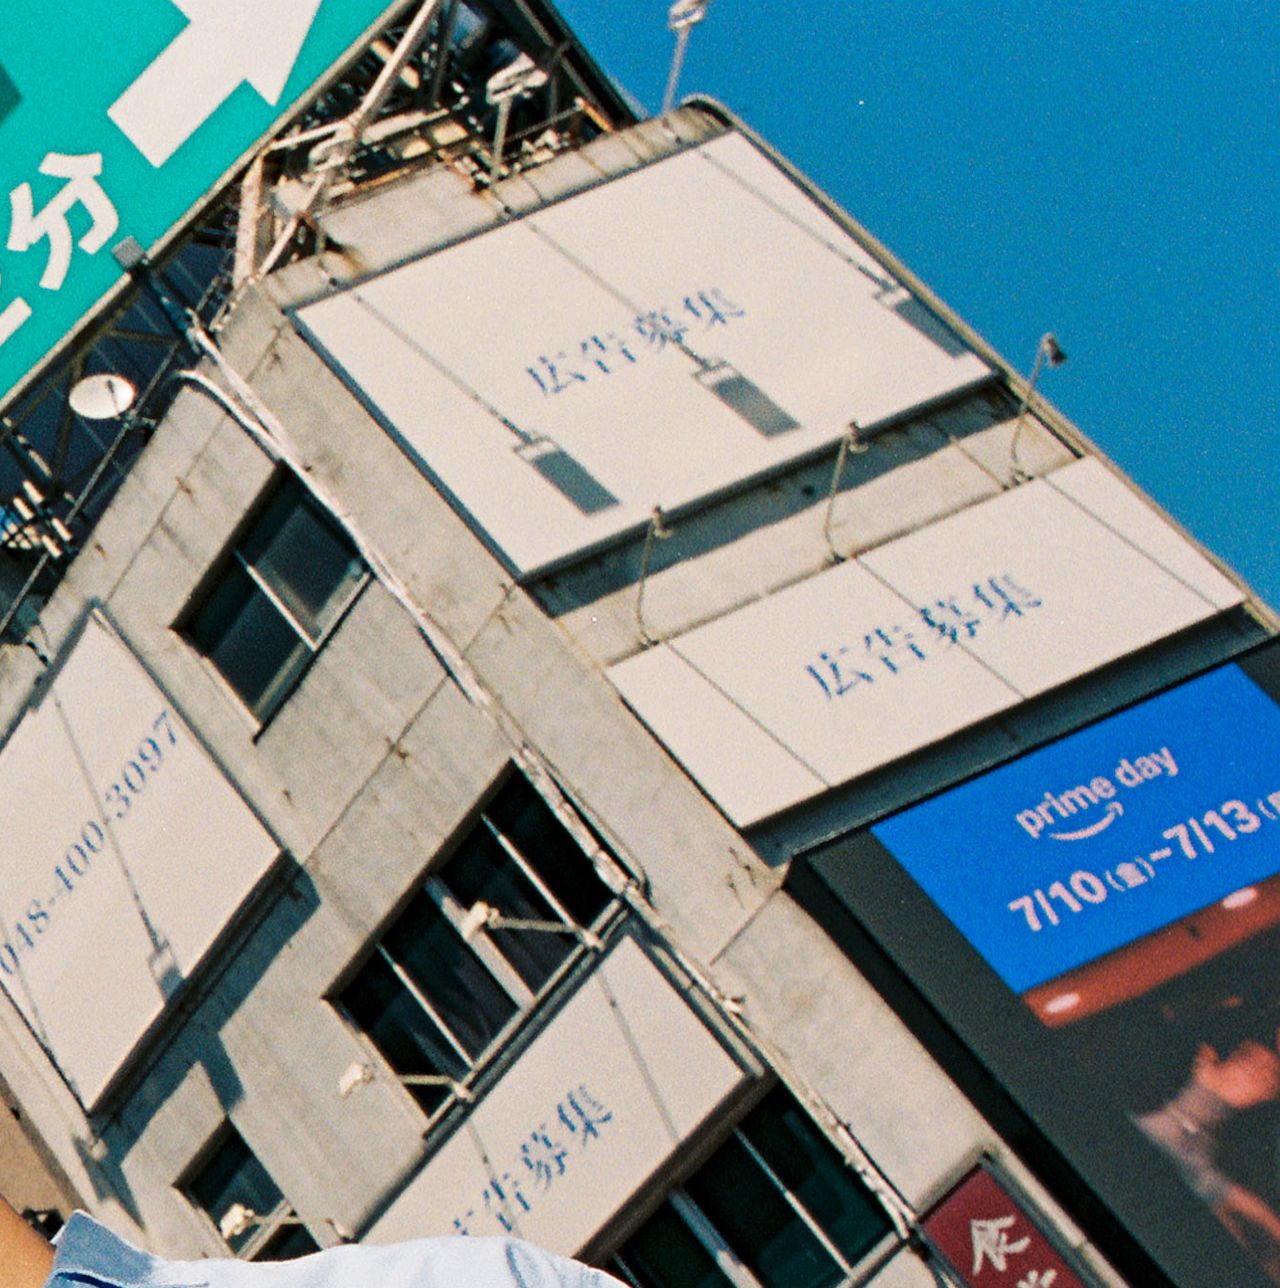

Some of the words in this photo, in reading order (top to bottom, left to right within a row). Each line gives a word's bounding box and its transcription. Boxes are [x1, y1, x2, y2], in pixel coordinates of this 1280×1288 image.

[523, 284, 747, 398] 広告募集
[803, 568, 1044, 701] 広告募集
[1016, 776, 1117, 840] prime
[1115, 747, 1179, 787] day
[453, 1084, 613, 1236] 告募集
